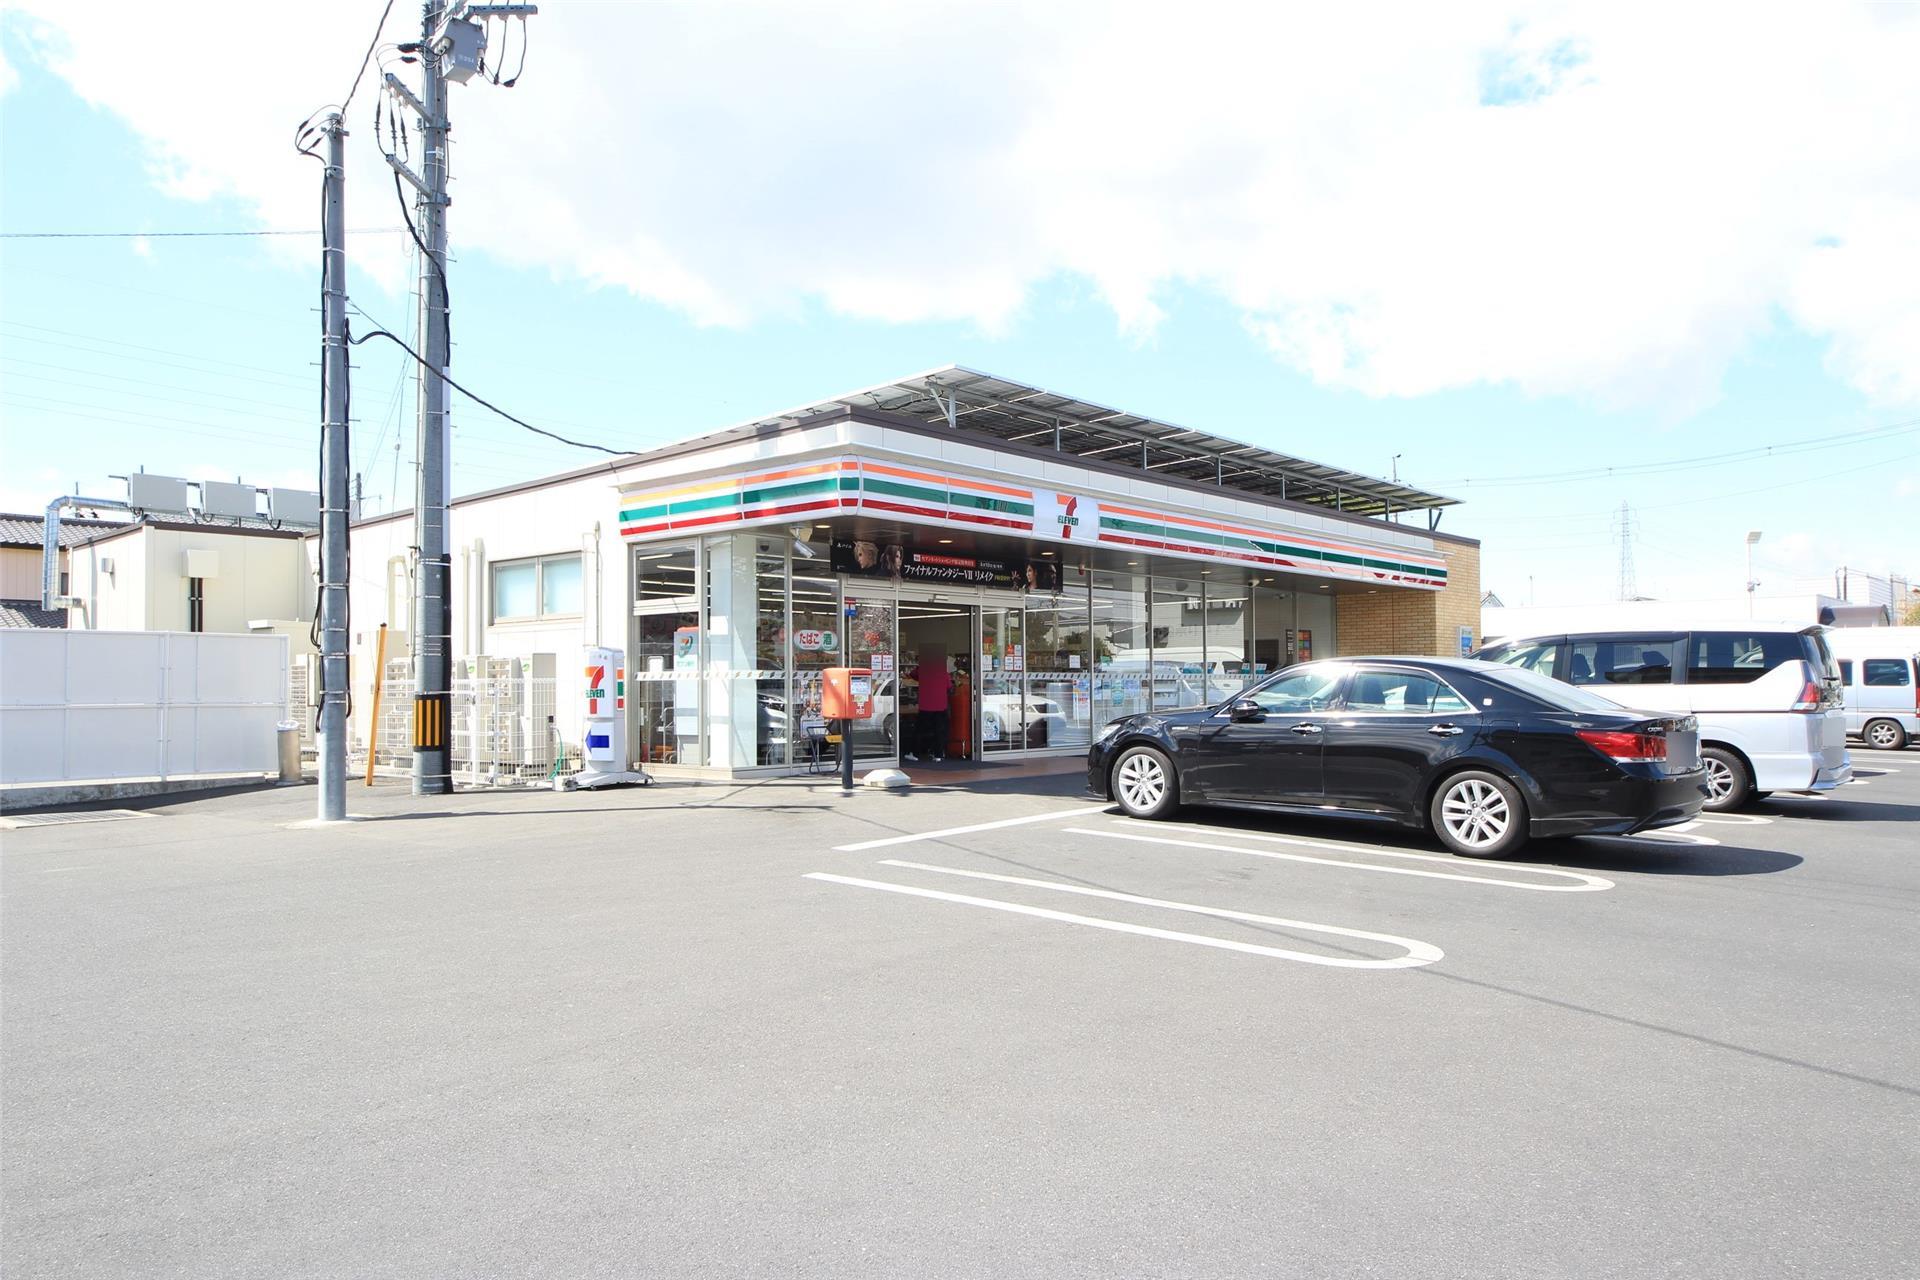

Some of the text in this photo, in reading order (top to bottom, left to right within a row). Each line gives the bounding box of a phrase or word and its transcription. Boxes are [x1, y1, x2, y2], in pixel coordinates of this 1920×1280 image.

[1056, 493, 1077, 539] 7
[974, 570, 994, 582] リメイク
[799, 633, 820, 645] たばこ
[823, 633, 833, 645] 酒
[584, 665, 605, 714] 7
